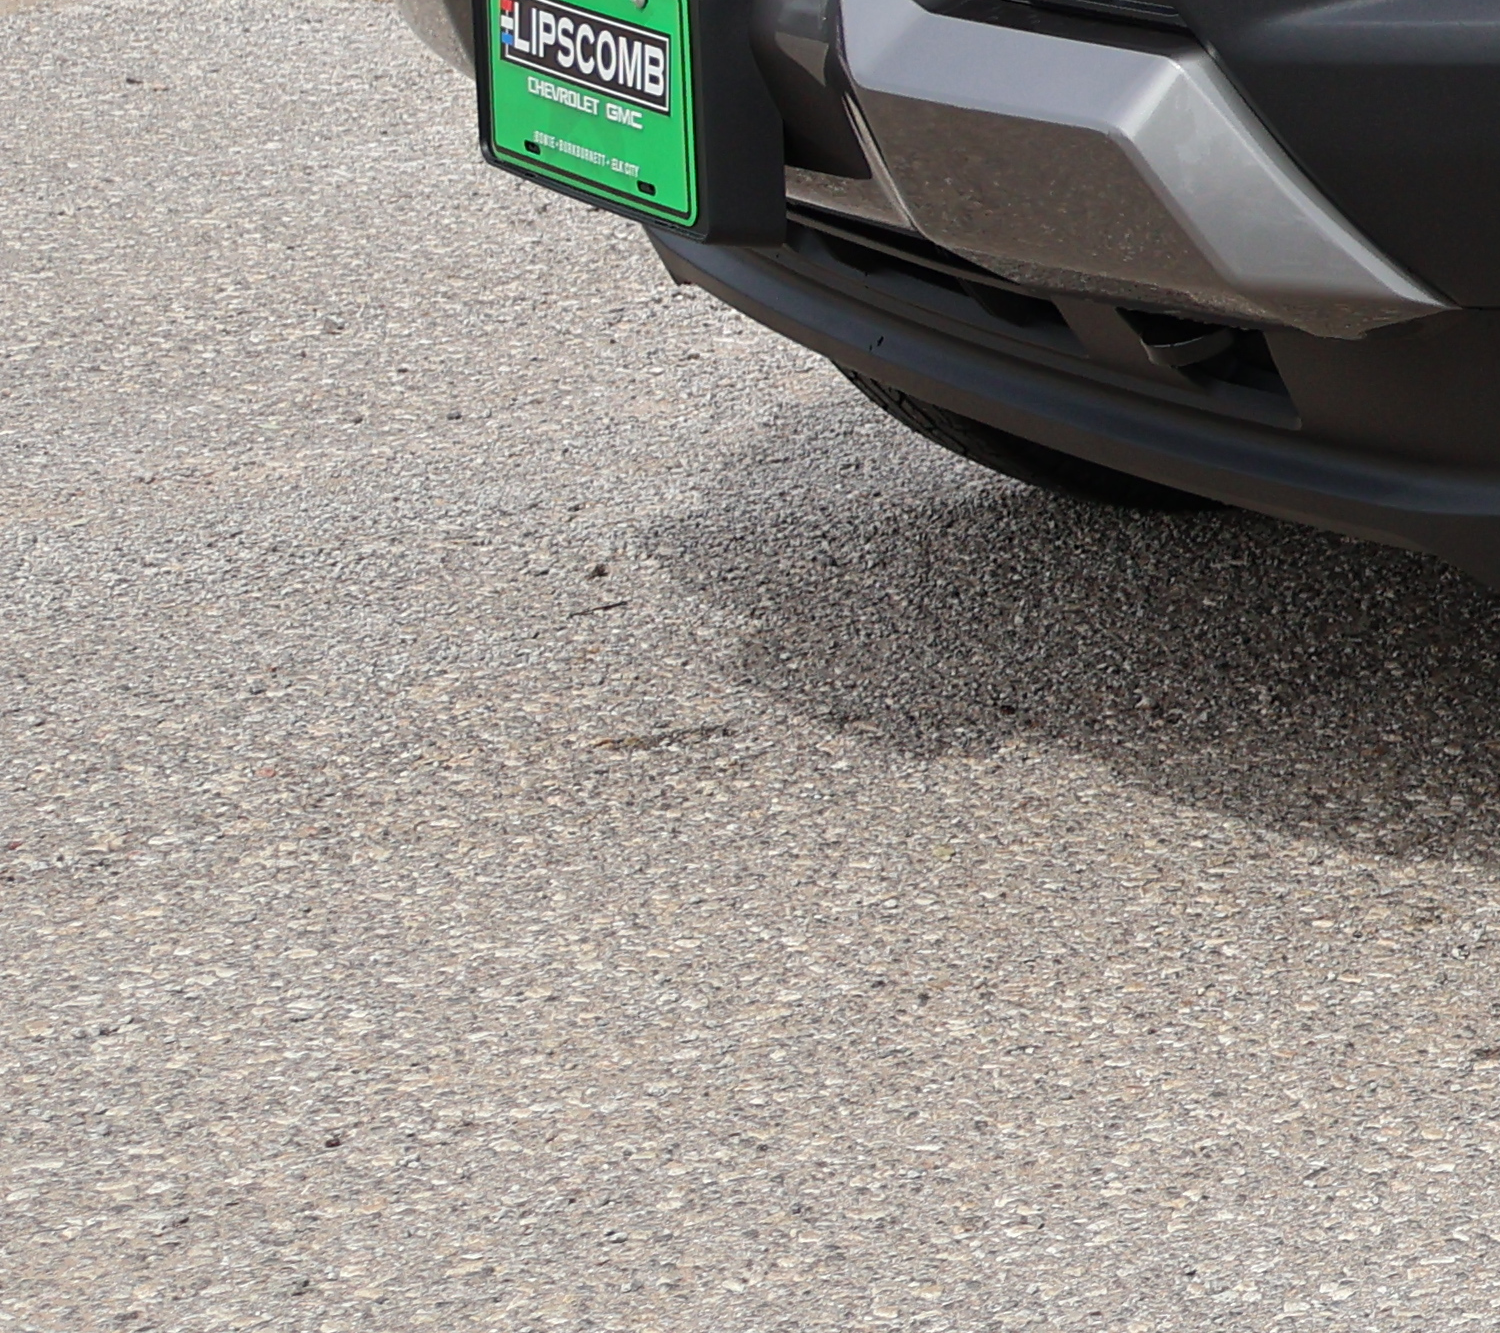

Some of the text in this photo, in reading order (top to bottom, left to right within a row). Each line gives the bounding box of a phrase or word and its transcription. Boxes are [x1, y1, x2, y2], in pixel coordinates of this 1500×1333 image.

[513, 1, 666, 97] LIPSCOMB
[527, 76, 643, 129] CHEVROLET GMC
